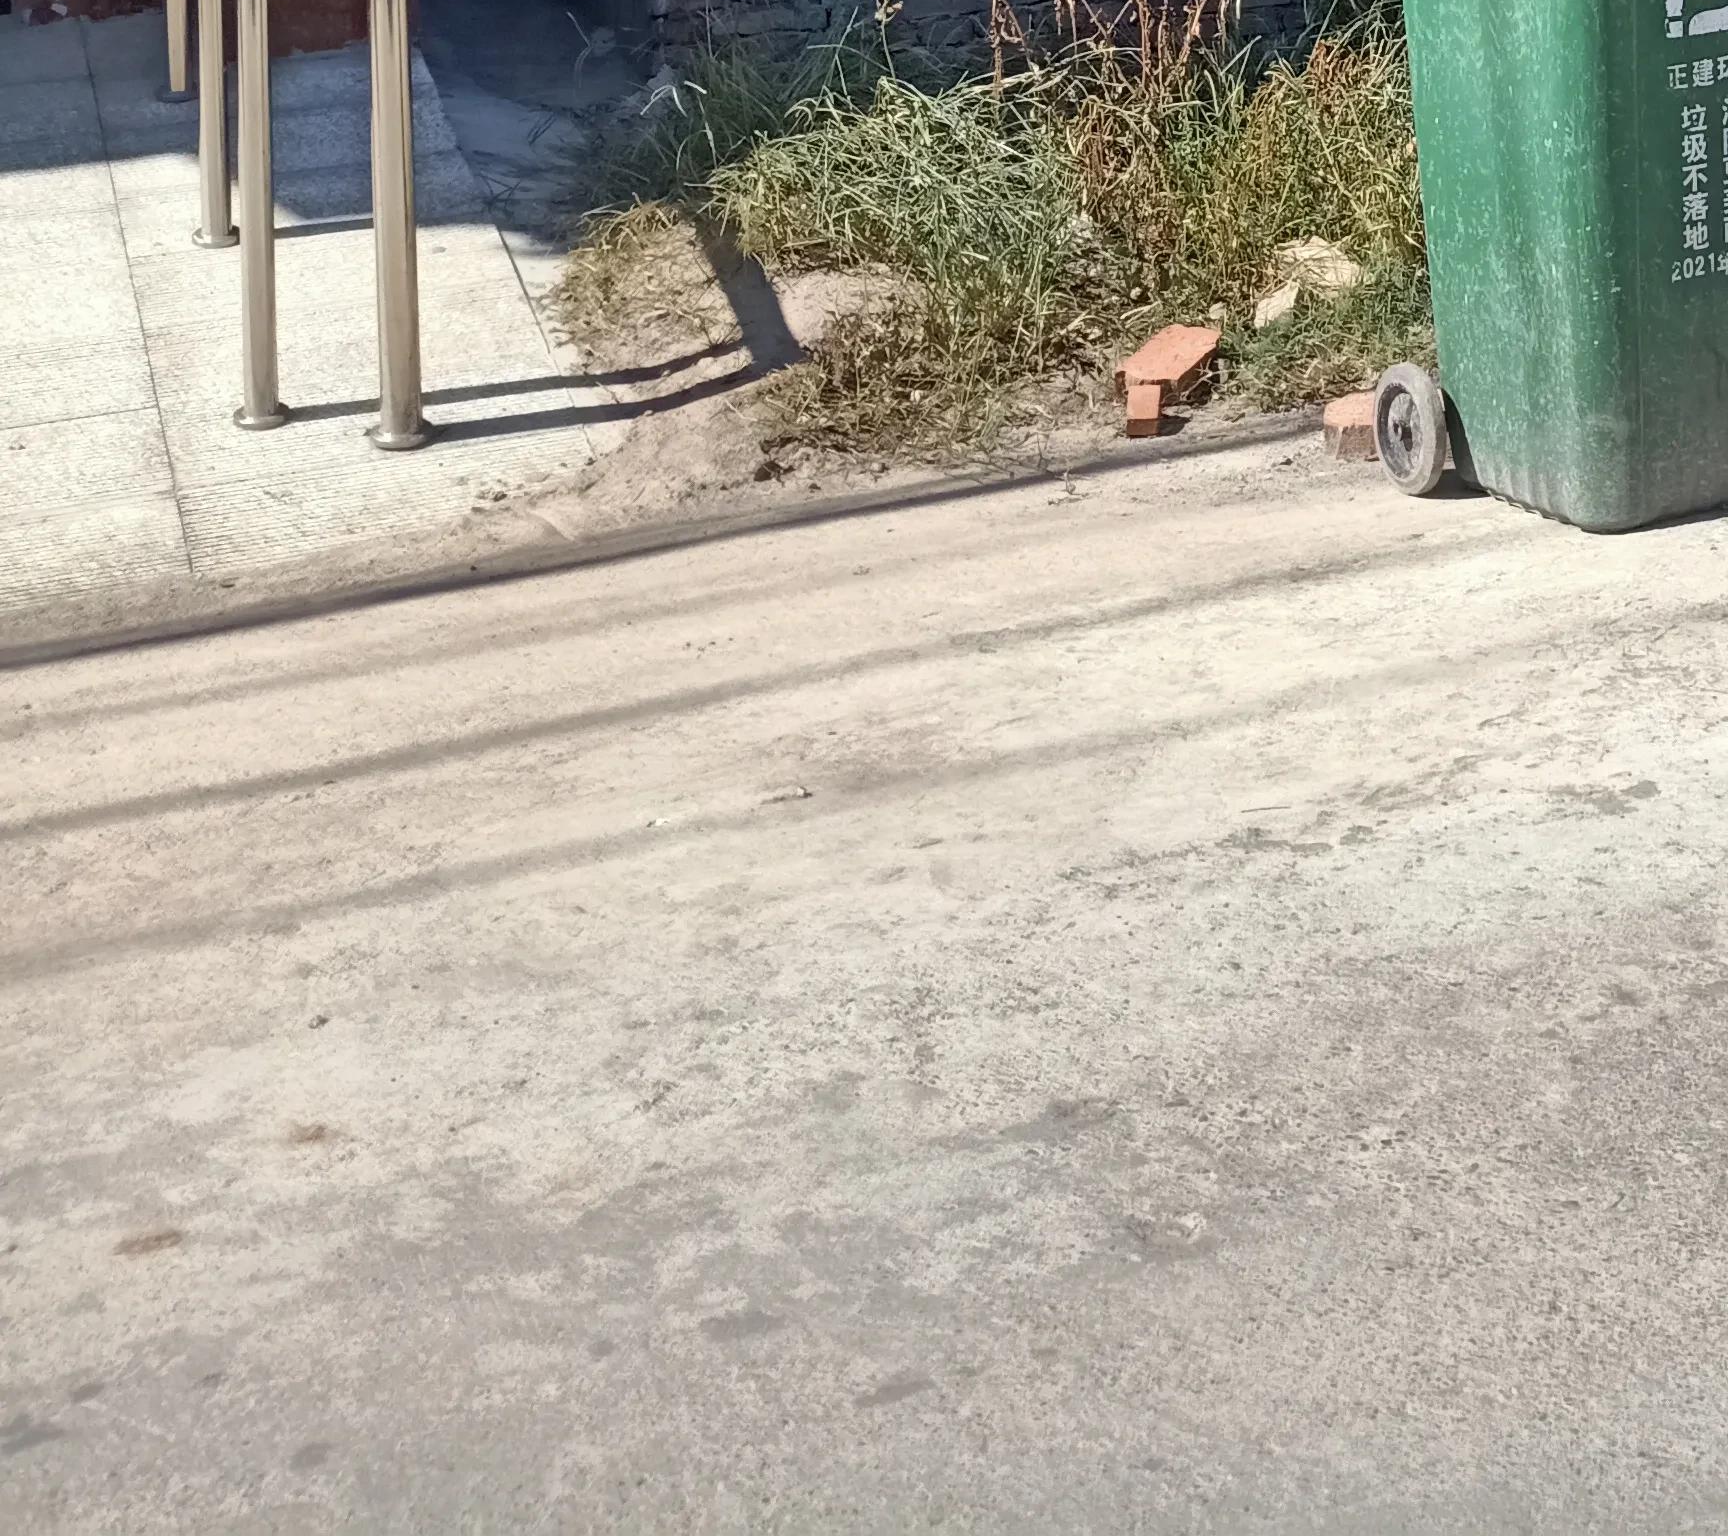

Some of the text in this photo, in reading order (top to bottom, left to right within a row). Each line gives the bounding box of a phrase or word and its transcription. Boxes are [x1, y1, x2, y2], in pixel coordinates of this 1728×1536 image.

[1681, 103, 1710, 251] 垃圾不落地
